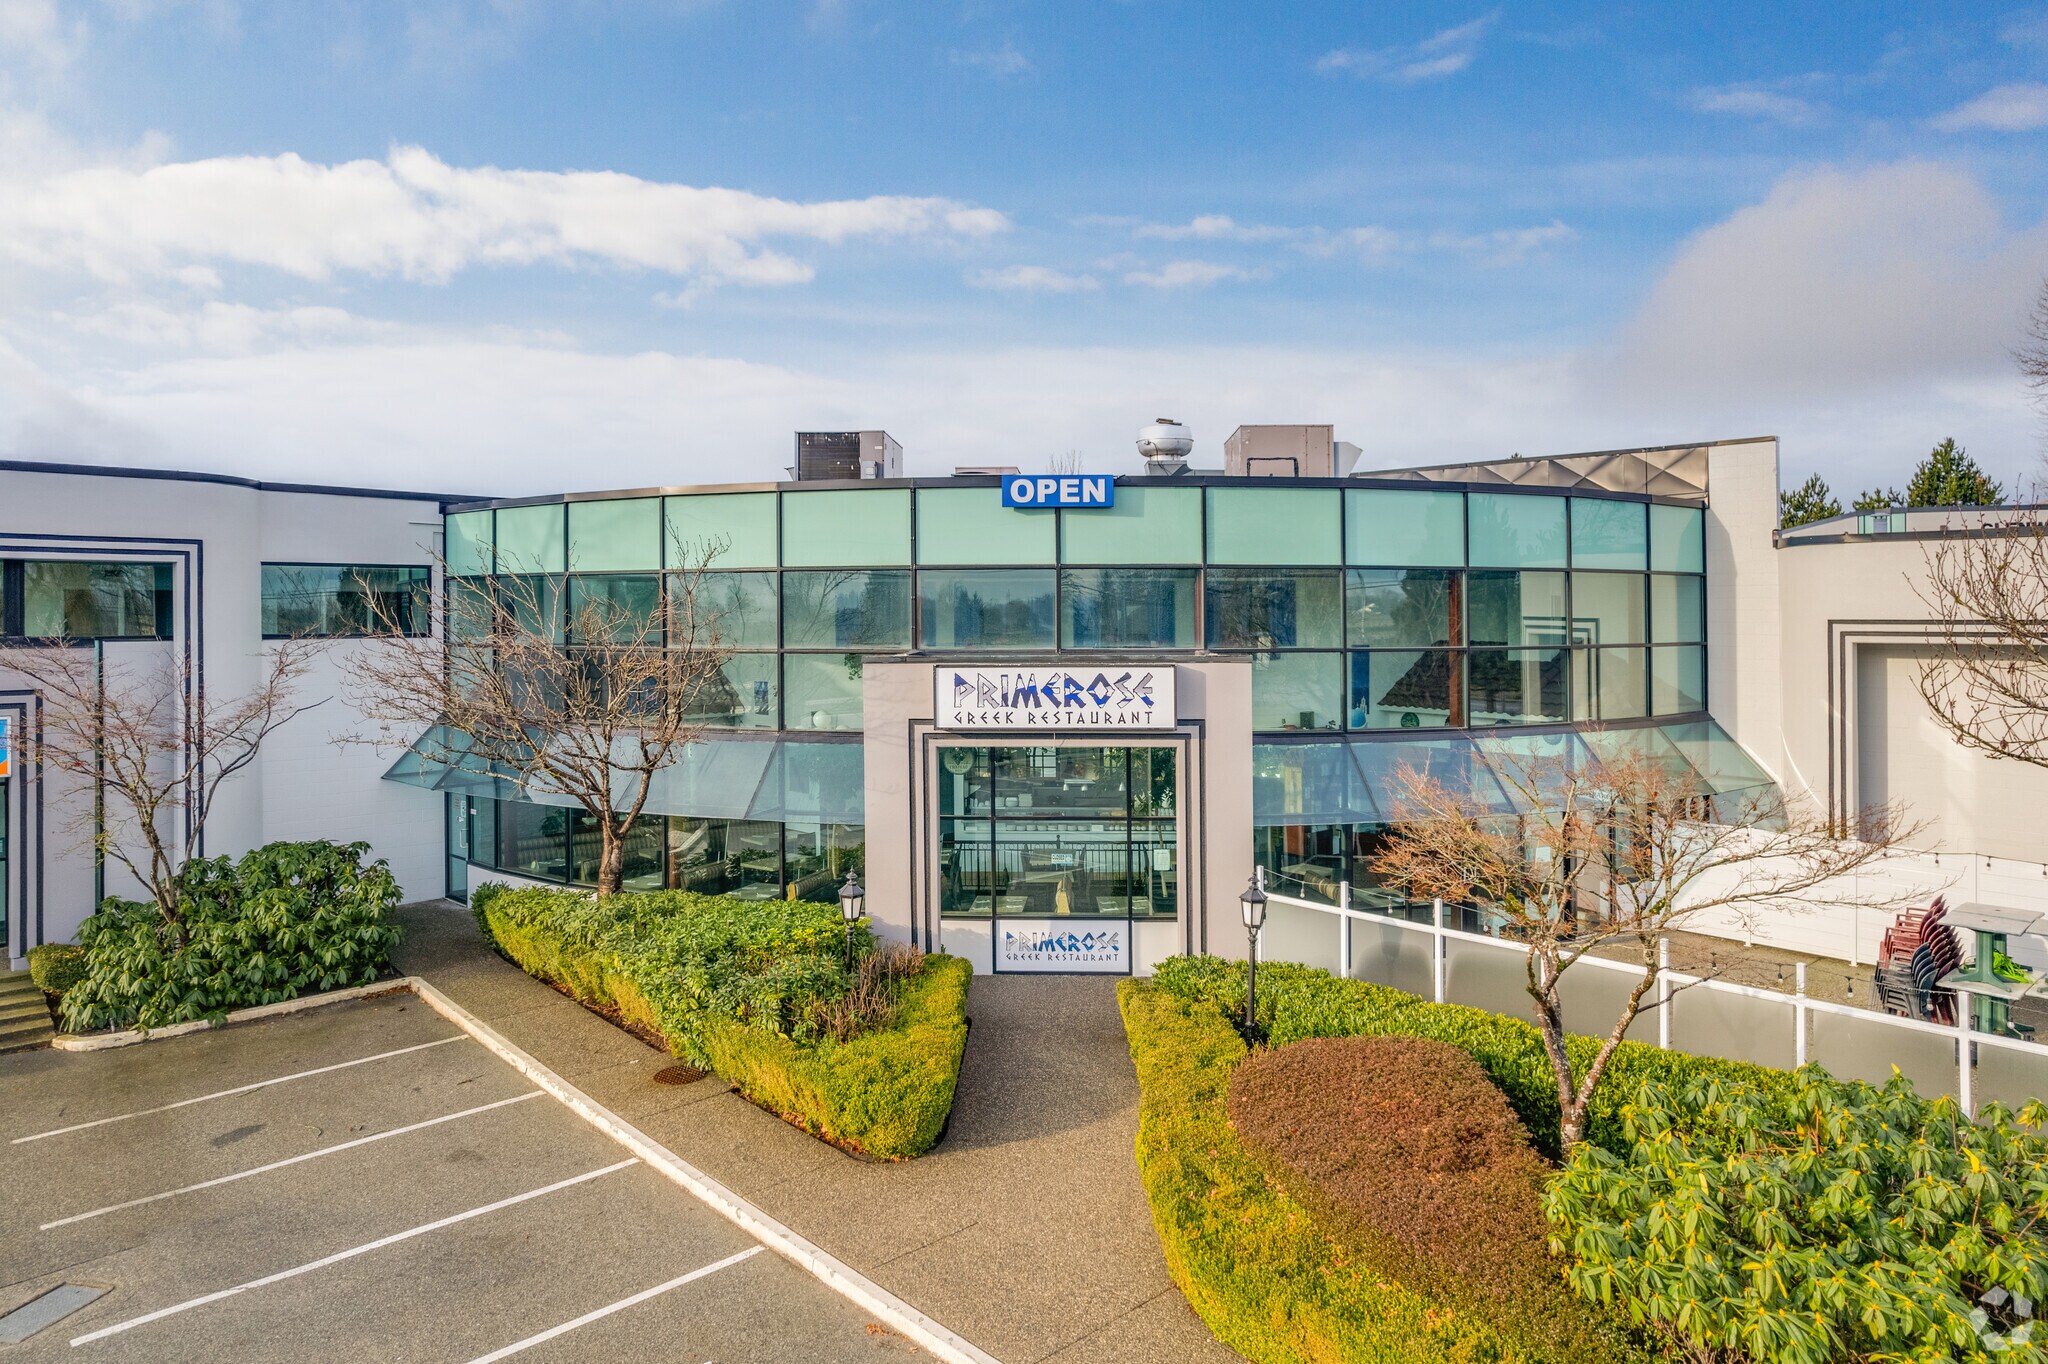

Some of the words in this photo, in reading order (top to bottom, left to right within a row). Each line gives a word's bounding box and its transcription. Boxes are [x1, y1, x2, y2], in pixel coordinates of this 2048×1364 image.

[1010, 478, 1105, 503] OPEN
[953, 672, 1155, 709] PRIMEROSE
[954, 711, 1014, 725] GREEK
[1028, 711, 1153, 725] RESTAURANT
[1005, 931, 1119, 952] PRIMEROSE
[1006, 953, 1040, 961] GREEK
[1048, 953, 1119, 962] RESTAURANT
